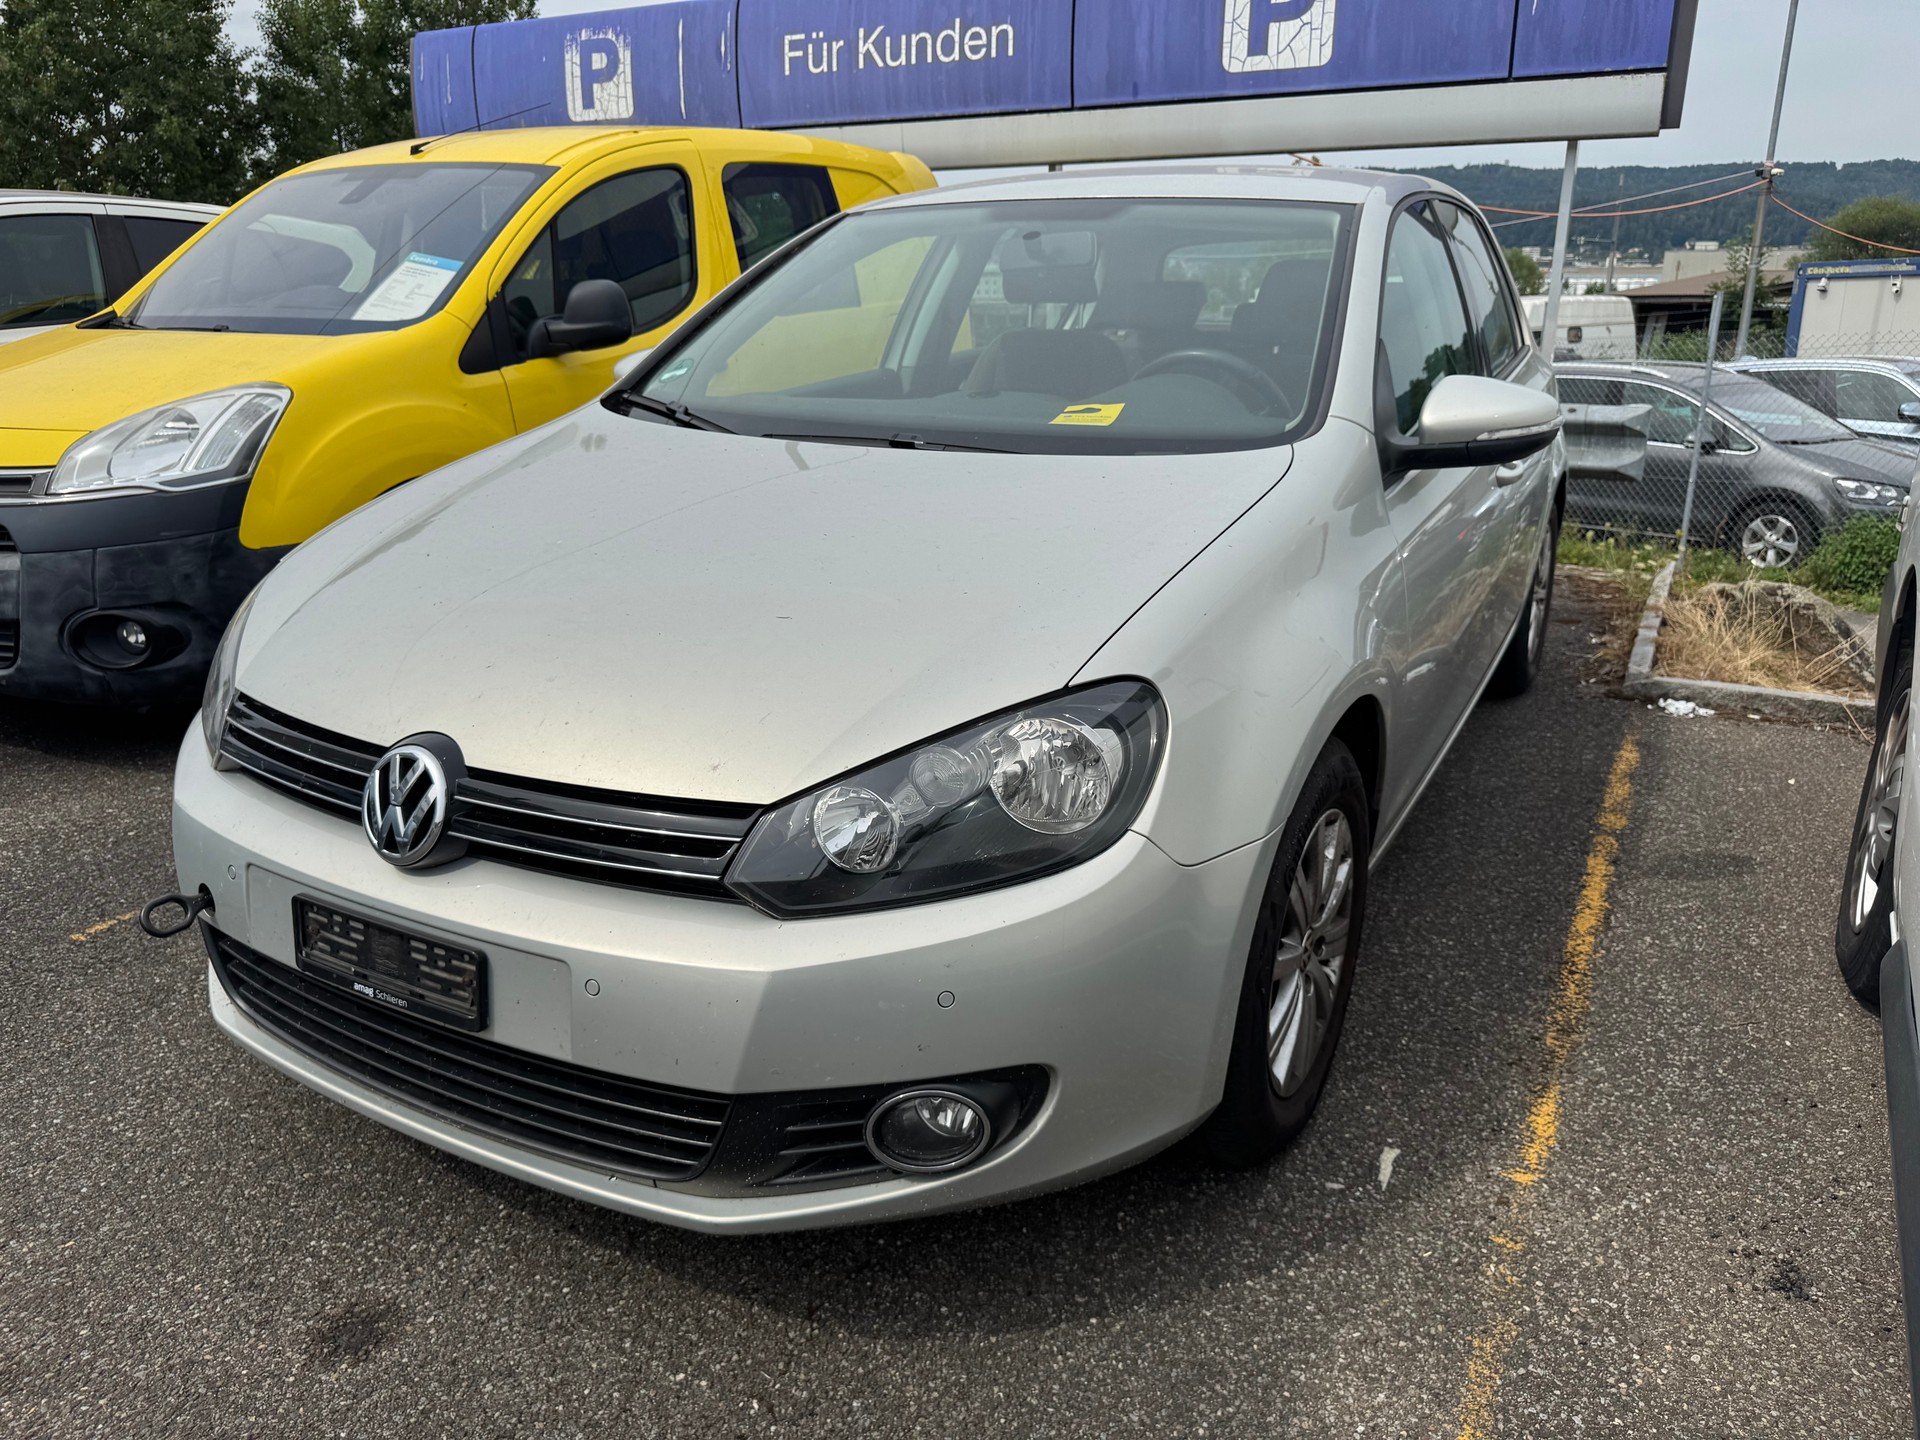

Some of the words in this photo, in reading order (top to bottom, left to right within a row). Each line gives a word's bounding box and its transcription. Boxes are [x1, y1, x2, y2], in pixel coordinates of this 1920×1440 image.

[578, 36, 621, 111] P
[784, 31, 844, 76] Für
[858, 17, 1014, 70] Kunden
[366, 749, 441, 860] VW
[353, 982, 374, 998] amag
[375, 989, 408, 1008] Schlieren
